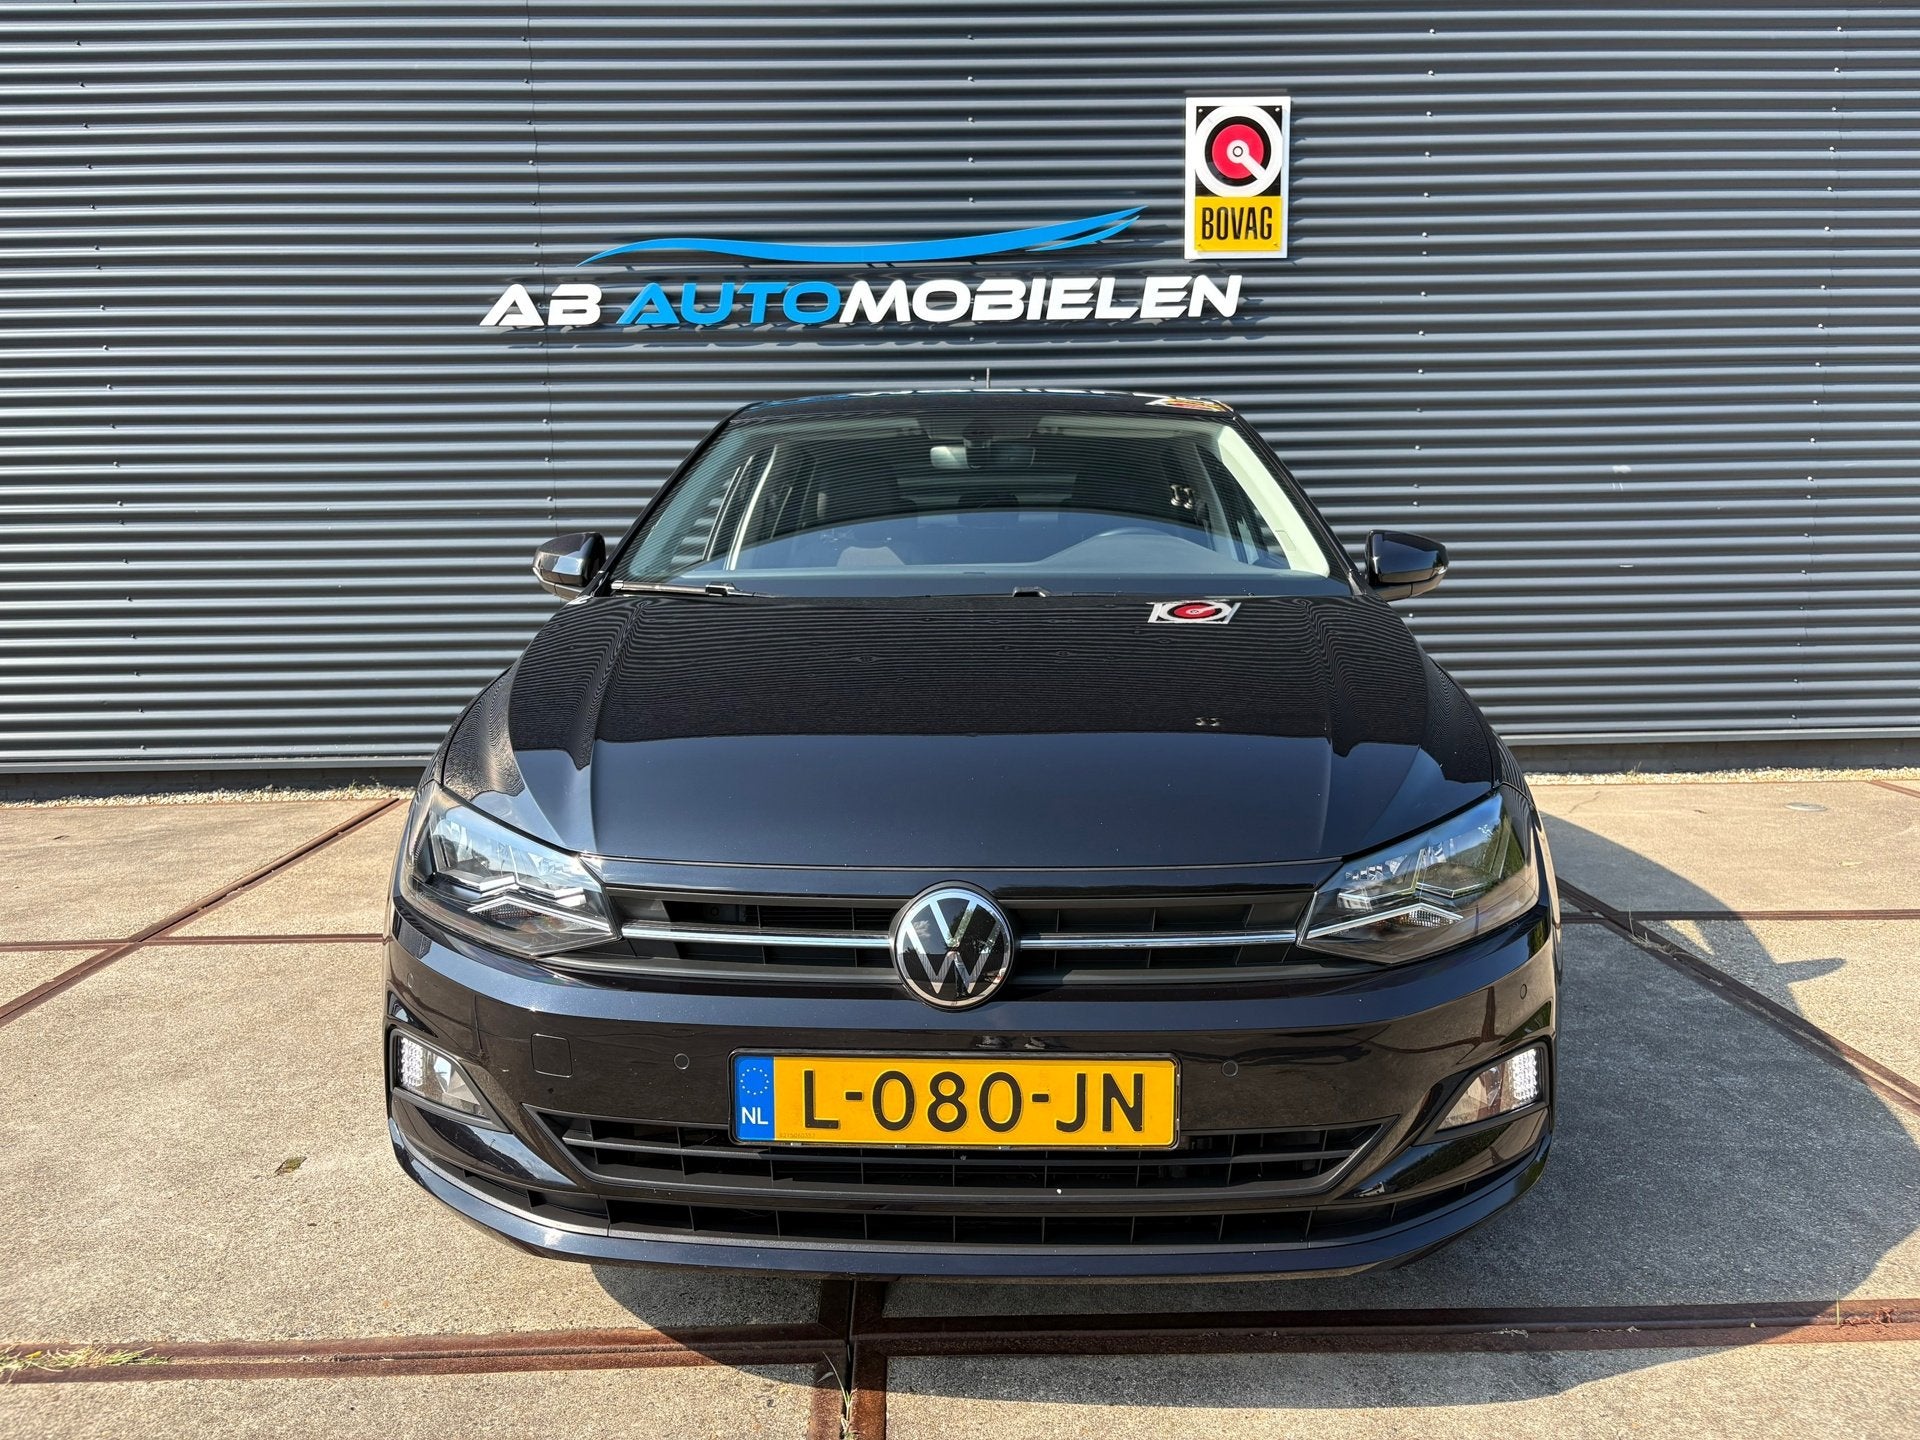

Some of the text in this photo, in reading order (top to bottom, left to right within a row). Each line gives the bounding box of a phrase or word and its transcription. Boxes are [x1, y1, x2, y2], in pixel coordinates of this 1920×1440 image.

[1202, 206, 1273, 241] BOVAG
[479, 275, 1243, 326] AB AUTOMOBIELEN
[902, 896, 1007, 996] VW
[741, 1107, 769, 1126] NL
[803, 1070, 1145, 1133] L-080-JN
